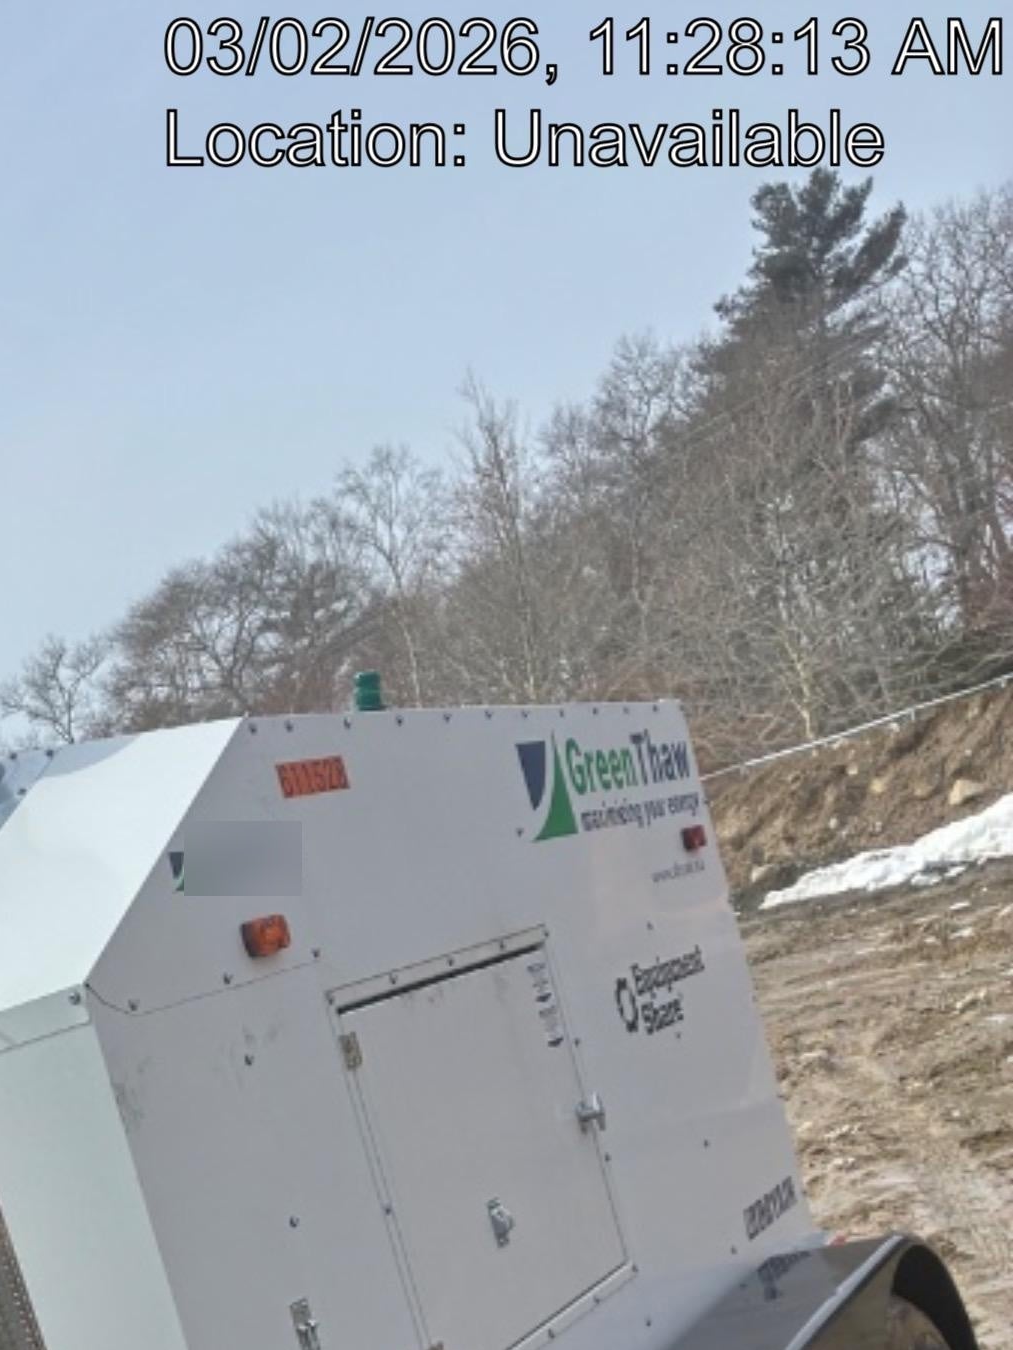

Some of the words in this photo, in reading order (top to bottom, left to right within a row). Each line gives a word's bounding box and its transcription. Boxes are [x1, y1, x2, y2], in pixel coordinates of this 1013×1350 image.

[565, 728, 691, 796] GreenThaw
[644, 799, 666, 827] your
[630, 944, 706, 996] Equipment
[641, 998, 685, 1035] Share
